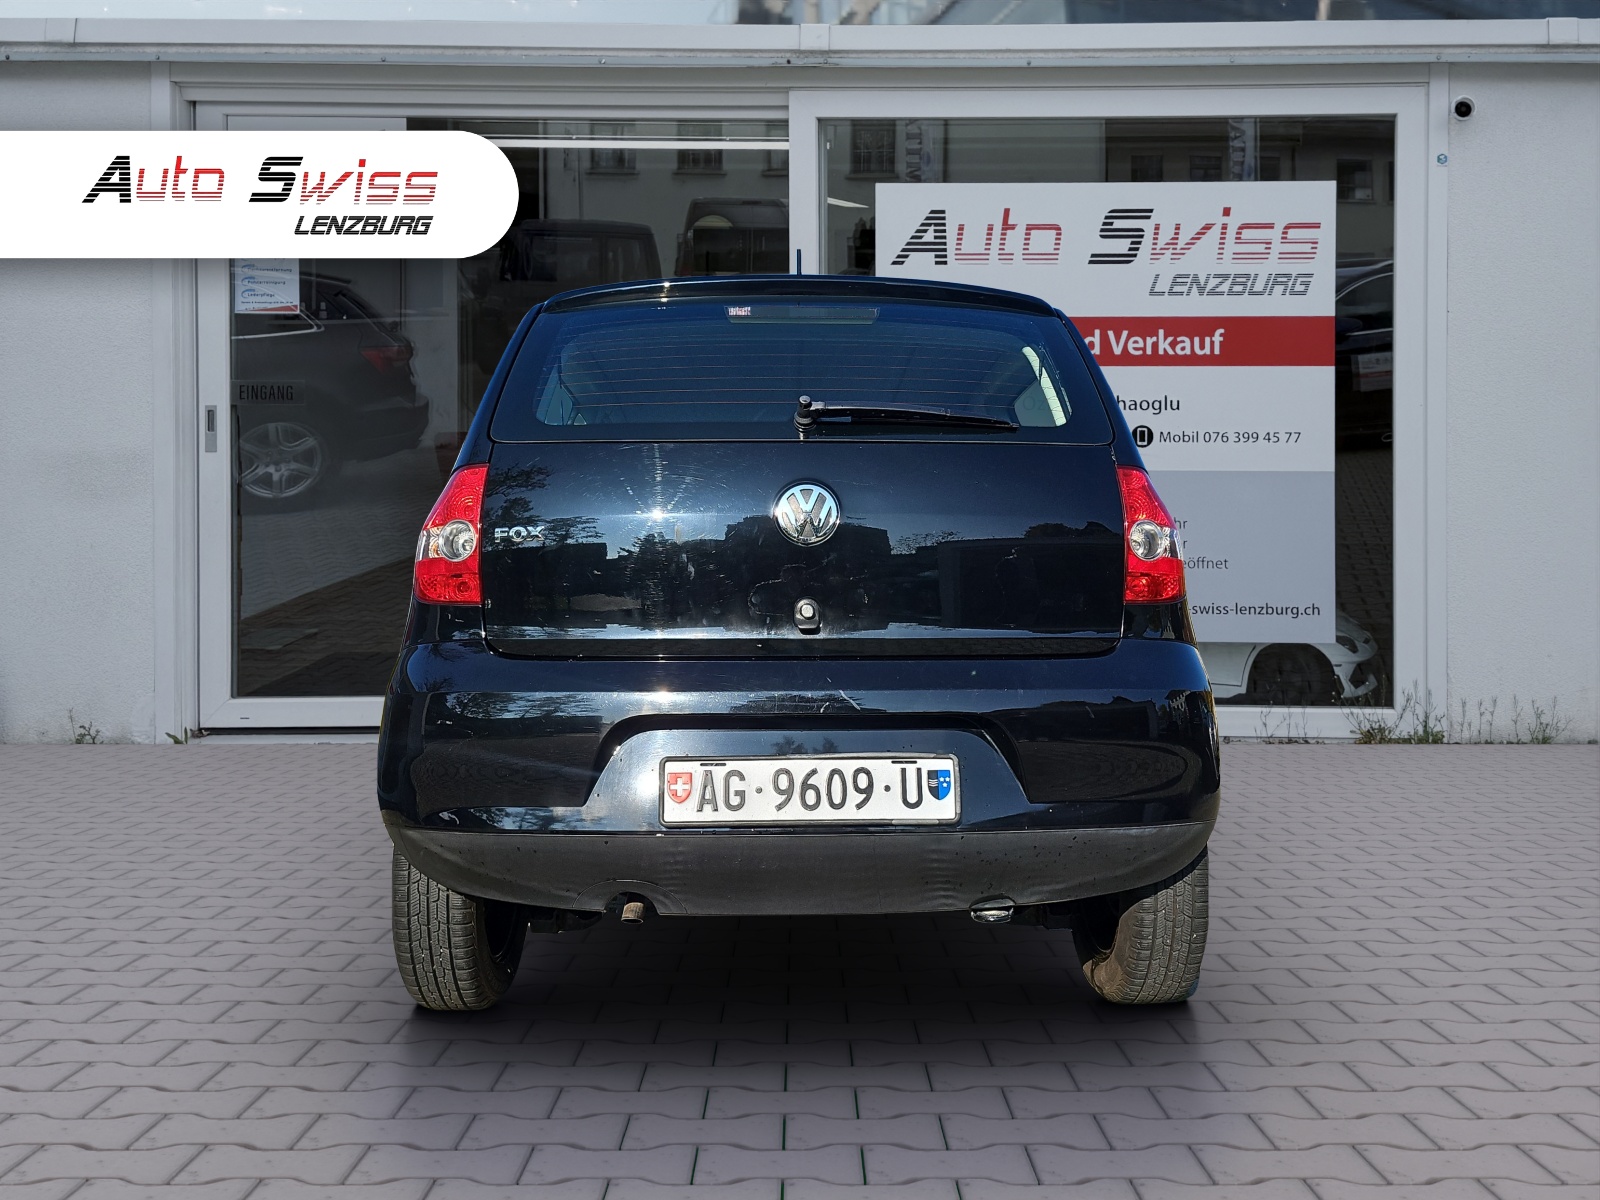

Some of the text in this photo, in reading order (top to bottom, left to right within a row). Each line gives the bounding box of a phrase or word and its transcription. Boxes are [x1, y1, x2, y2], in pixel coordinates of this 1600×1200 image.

[890, 207, 1322, 266] Auto Swiss
[1149, 273, 1315, 297] LENZBURG
[1107, 328, 1226, 356] Verkauf
[239, 384, 294, 401] EINGANG
[1159, 430, 1301, 444] Mobil 076 399 45 77
[494, 525, 545, 543] FOX
